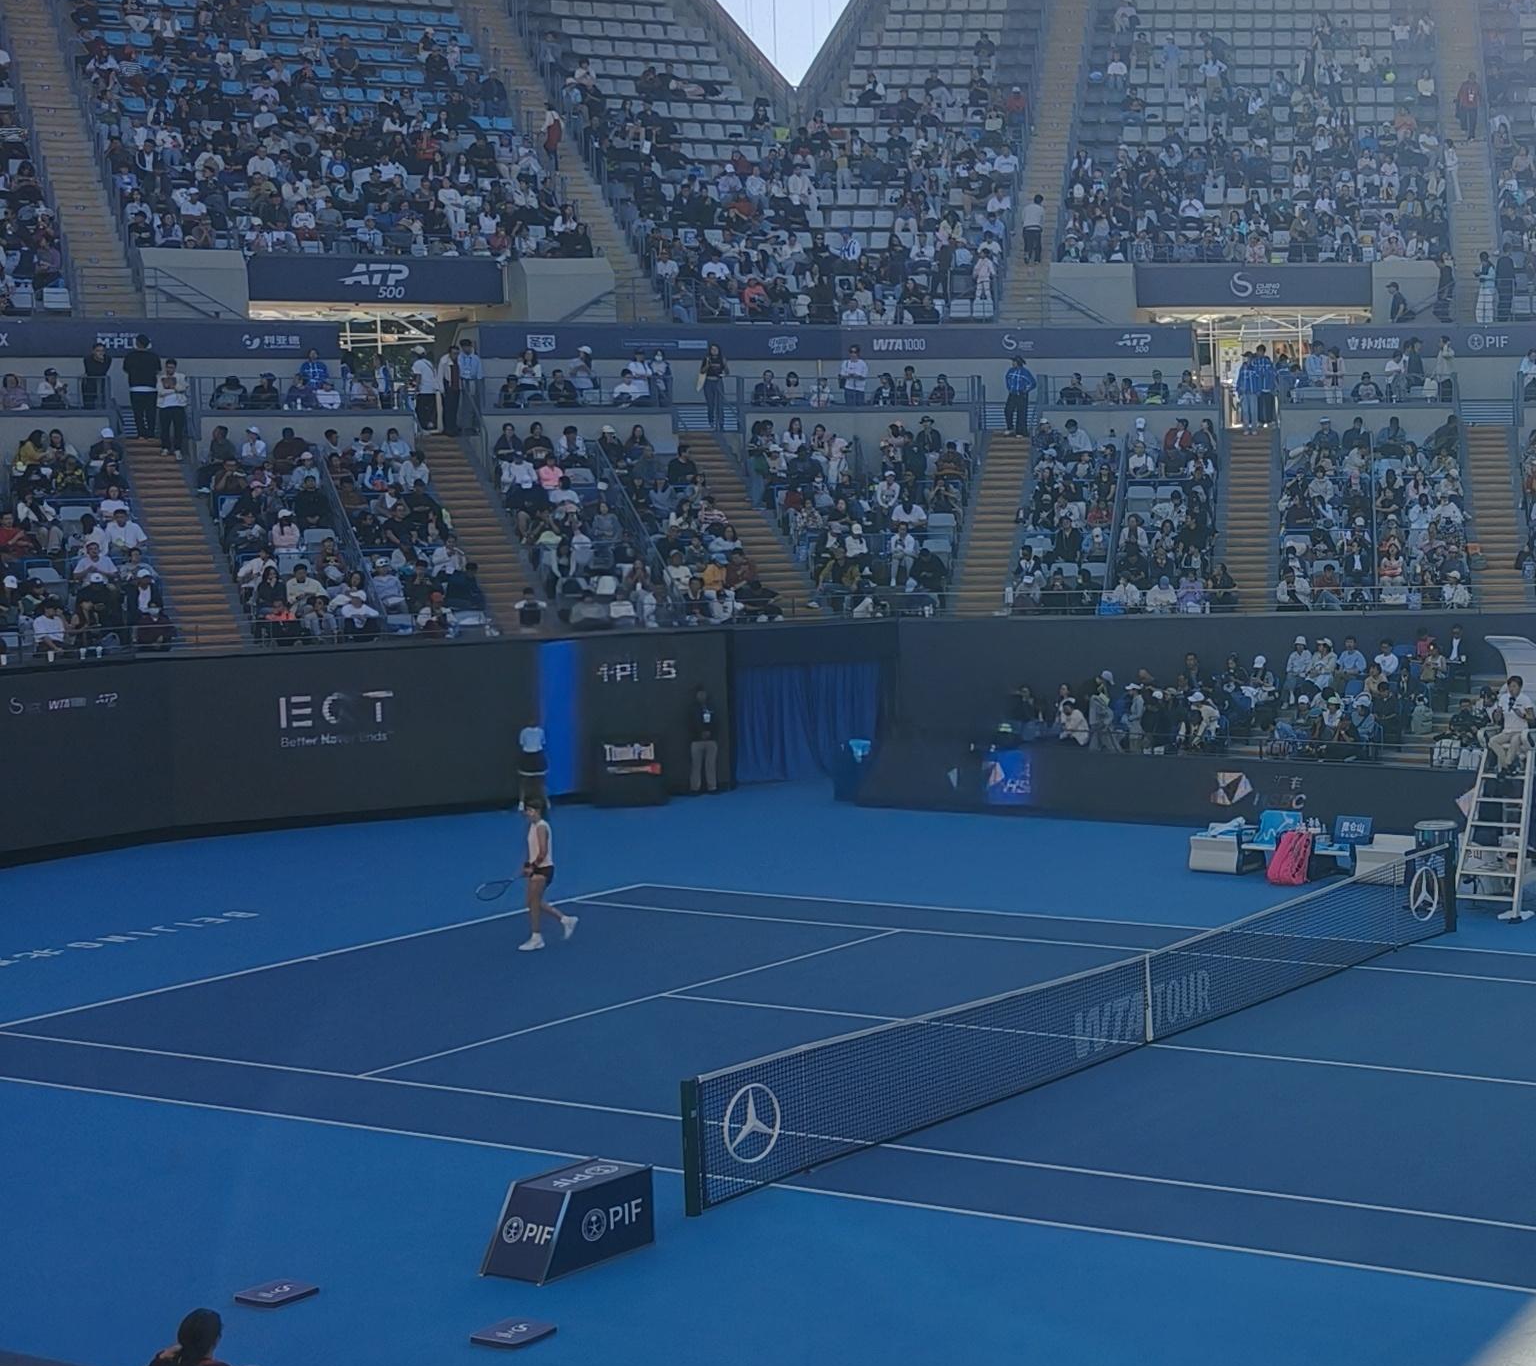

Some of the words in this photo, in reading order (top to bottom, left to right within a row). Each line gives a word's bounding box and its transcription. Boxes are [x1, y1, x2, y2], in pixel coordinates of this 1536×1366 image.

[337, 263, 409, 285] ATP
[377, 286, 405, 299] 500
[1115, 334, 1151, 346] ATP
[1486, 336, 1509, 348] PIF
[609, 1198, 643, 1230] PIF
[522, 1223, 554, 1245] PIF
